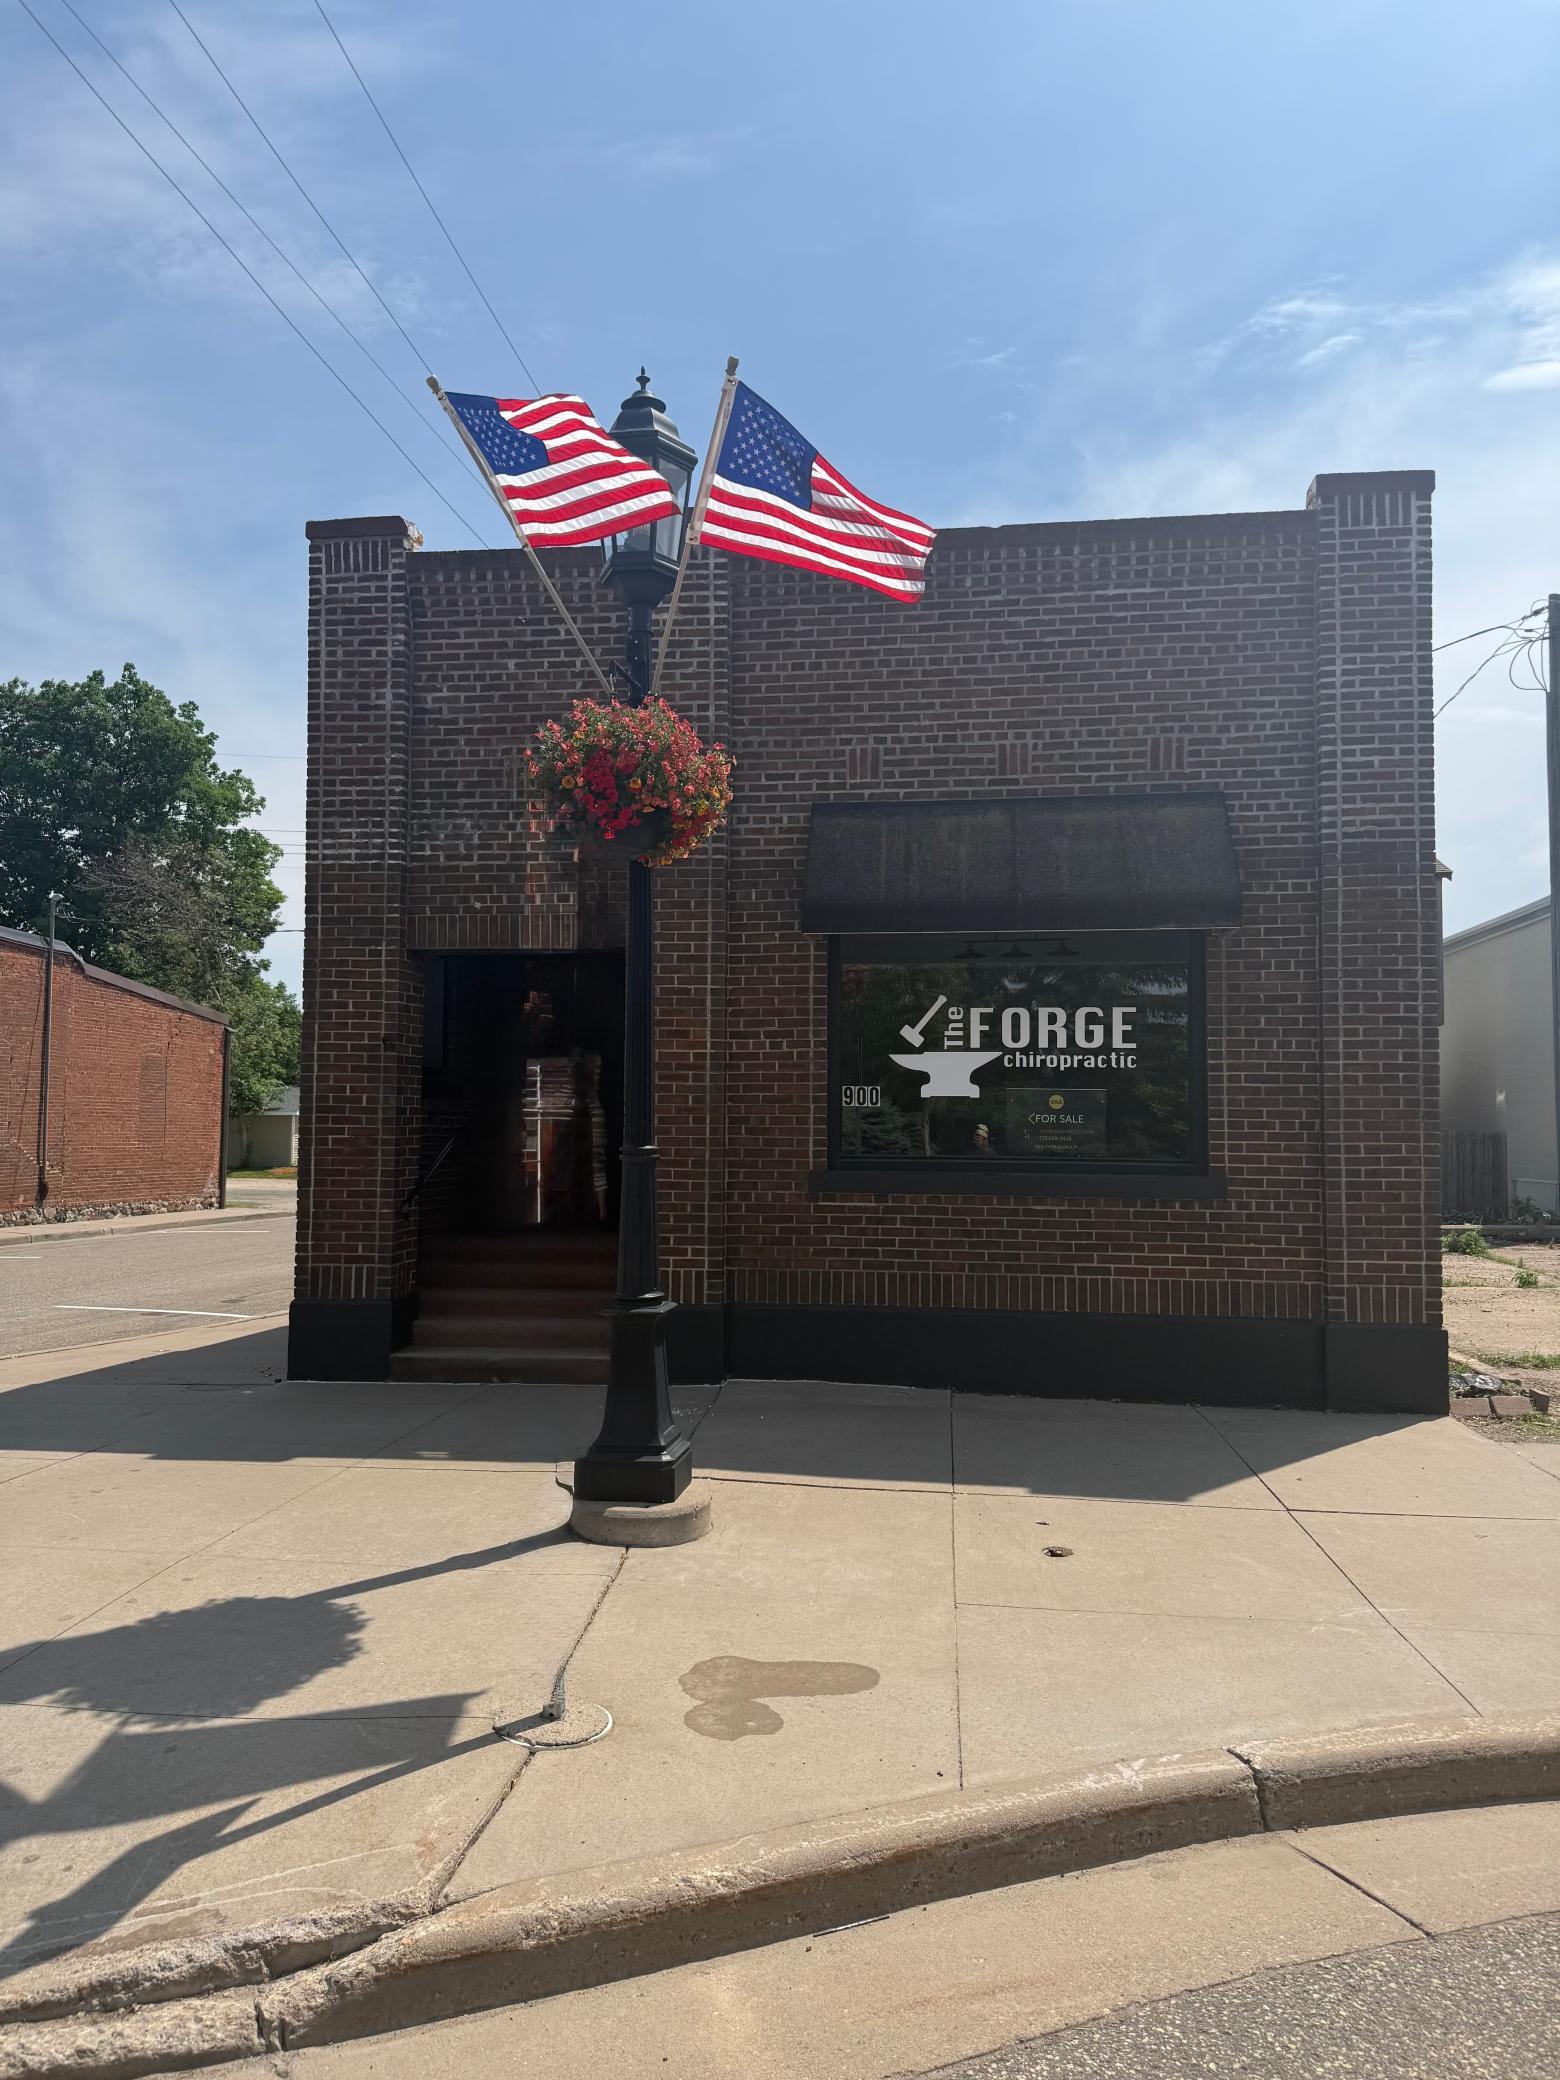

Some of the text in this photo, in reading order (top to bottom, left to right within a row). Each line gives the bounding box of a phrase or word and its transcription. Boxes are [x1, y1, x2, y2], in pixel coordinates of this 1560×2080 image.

[944, 1006, 1137, 1050] The FORGE
[1003, 1051, 1137, 1071] chiropractic
[843, 1086, 880, 1106] 900
[1035, 1114, 1085, 1124] FOR SALE
